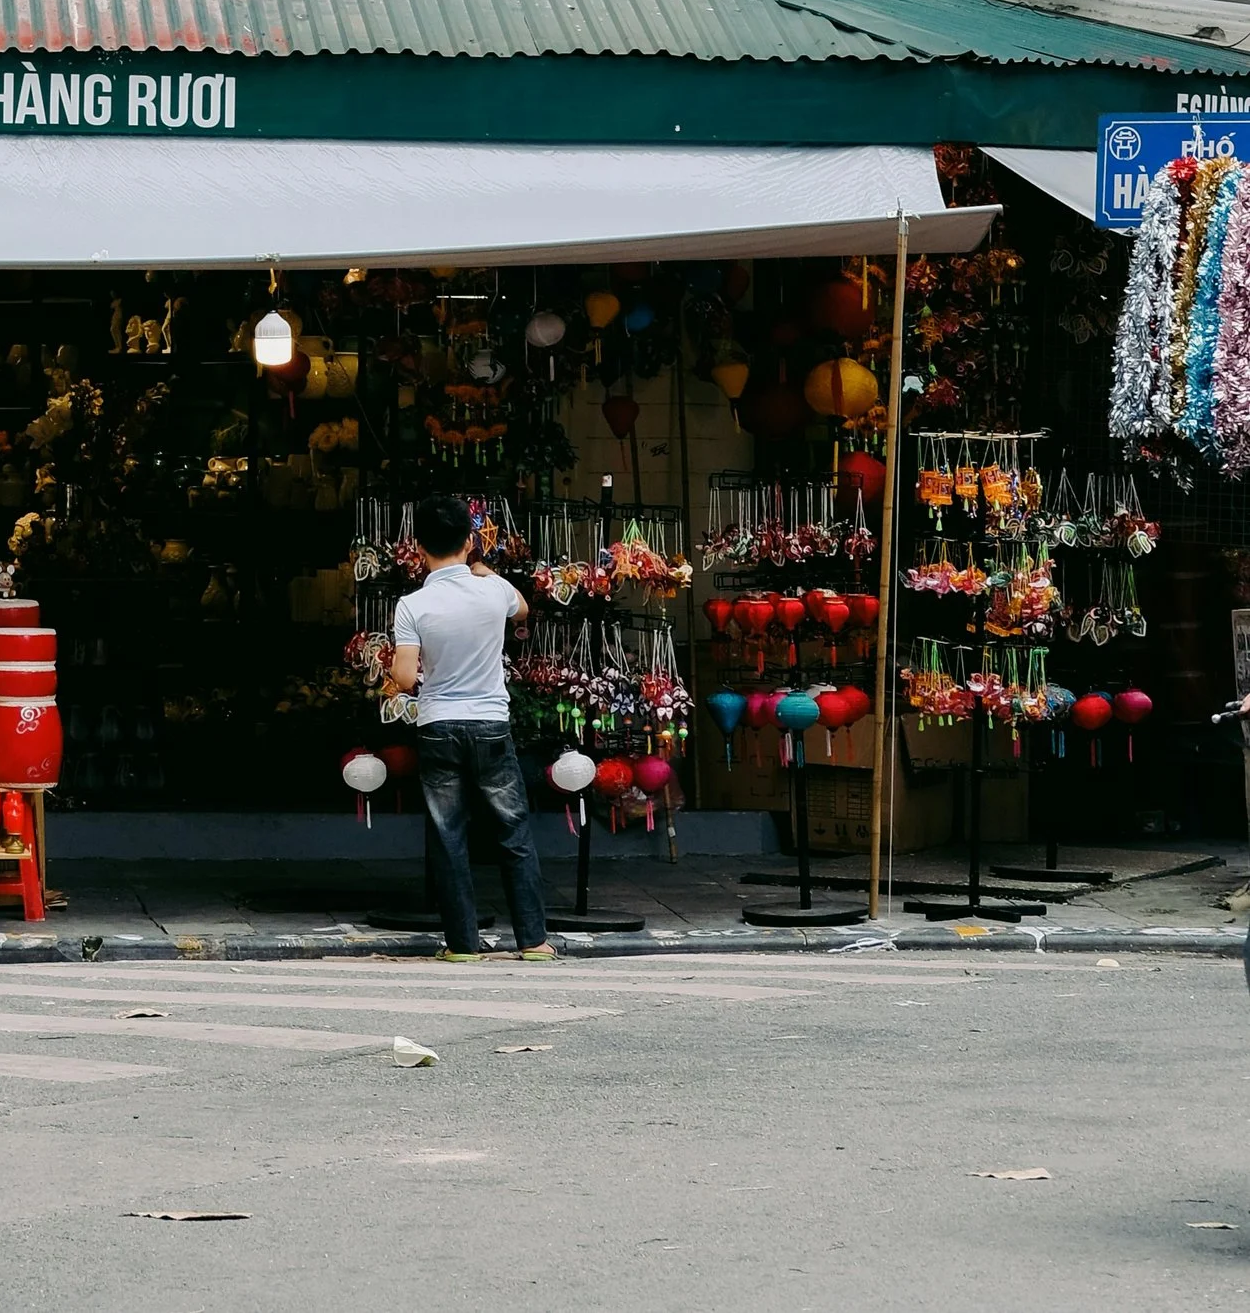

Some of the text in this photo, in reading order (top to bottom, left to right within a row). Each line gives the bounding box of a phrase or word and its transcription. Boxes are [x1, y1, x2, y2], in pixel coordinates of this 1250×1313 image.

[128, 72, 236, 129] RƯƠI
[1181, 131, 1236, 159] PHỐ
[1113, 165, 1150, 209] HÀ
